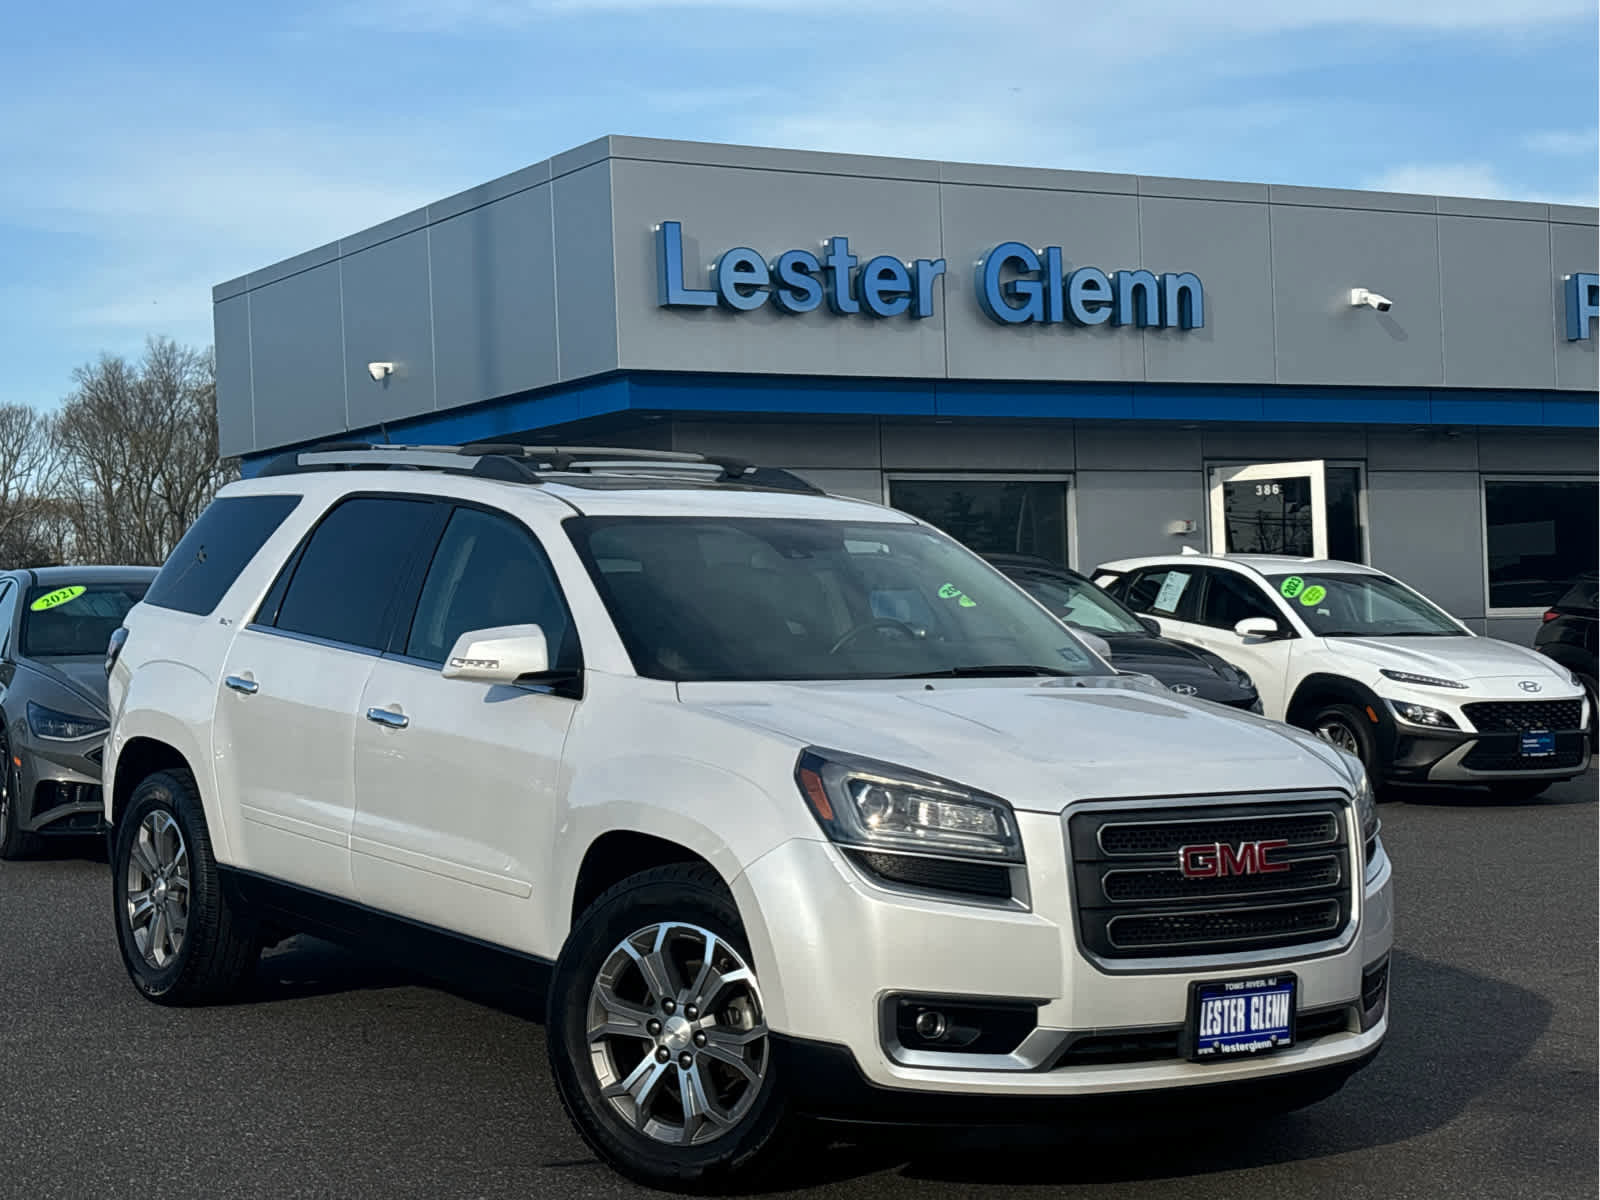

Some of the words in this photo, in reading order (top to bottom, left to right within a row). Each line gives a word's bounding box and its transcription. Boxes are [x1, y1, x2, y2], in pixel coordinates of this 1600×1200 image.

[655, 221, 945, 318] Lester
[977, 241, 1205, 329] Glenn
[1255, 483, 1280, 496] 386
[42, 588, 76, 608] 2021
[1283, 577, 1302, 596] 2023
[1179, 839, 1289, 877] GMC
[1200, 998, 1246, 1036] LESTER
[1250, 993, 1290, 1031] GLENN
